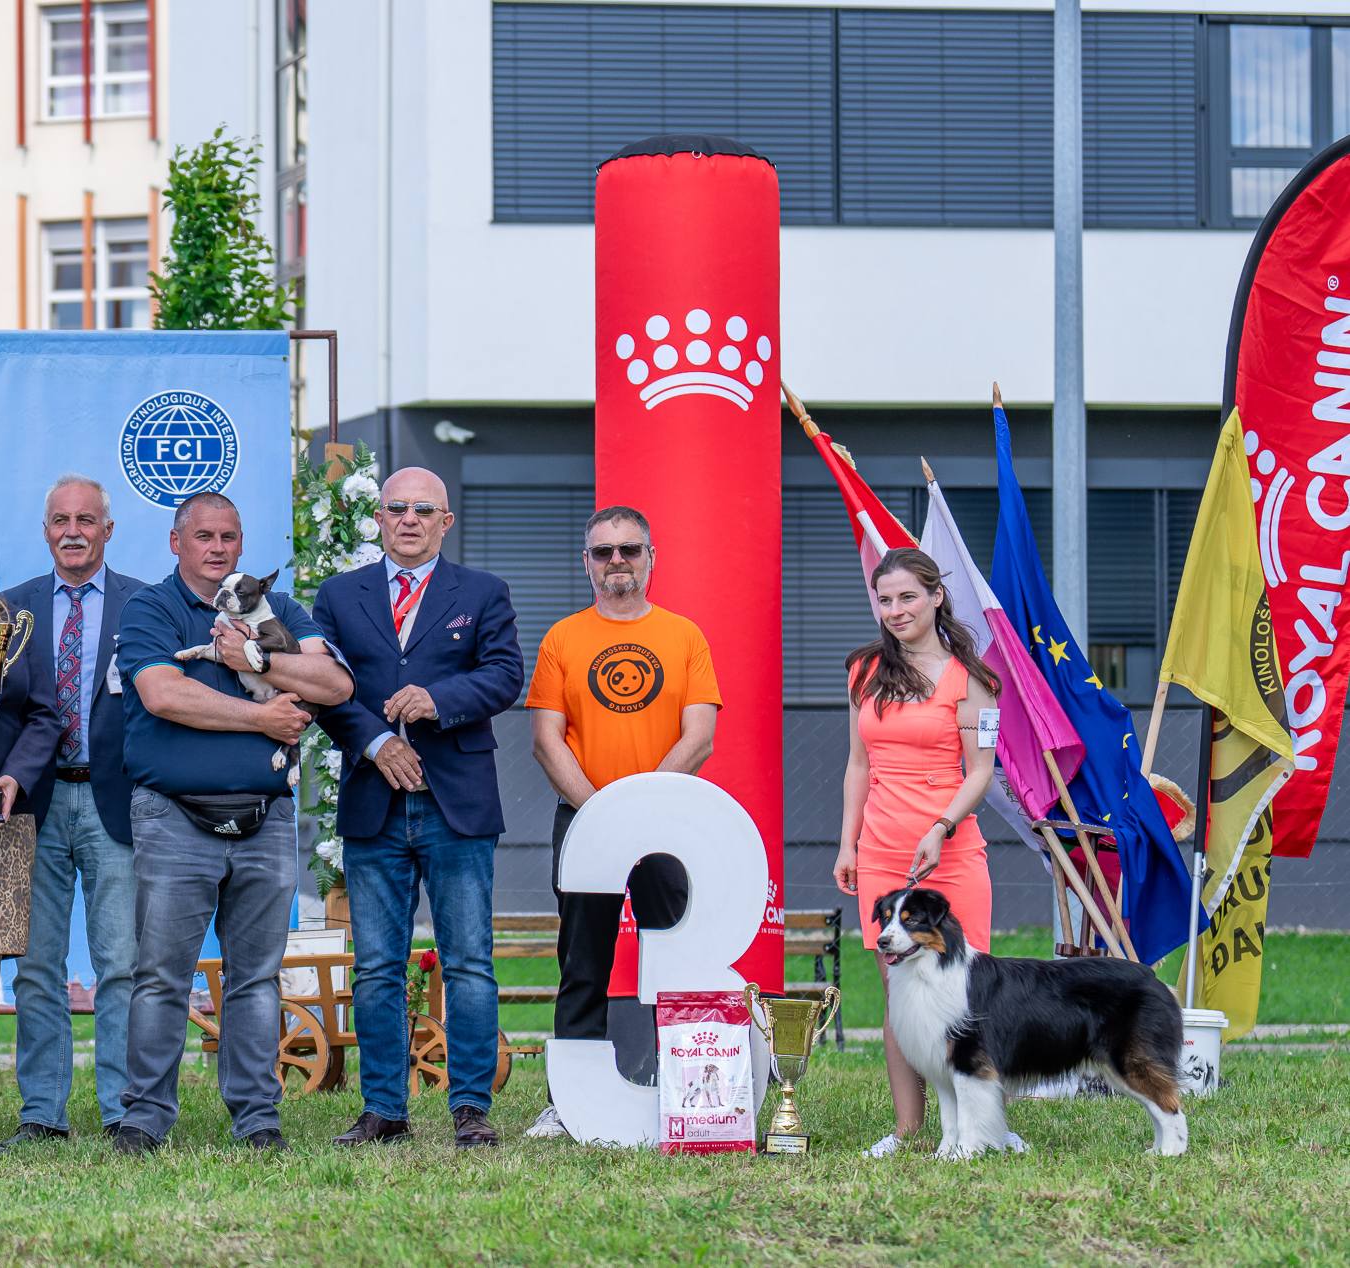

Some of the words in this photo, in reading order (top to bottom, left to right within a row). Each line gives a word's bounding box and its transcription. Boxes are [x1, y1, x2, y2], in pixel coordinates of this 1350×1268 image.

[129, 393, 209, 430] CYNOLOGIQUE
[123, 433, 161, 501] FEDERATION
[156, 439, 202, 461] FCI
[204, 408, 237, 492] INTERNATIONAL
[1254, 601, 1278, 695] KINOLOŠ
[545, 771, 770, 1148] 3
[671, 1047, 704, 1057] ROYAL
[671, 1120, 682, 1135] M
[686, 1114, 737, 1125] medium
[687, 1129, 710, 1138] adult
